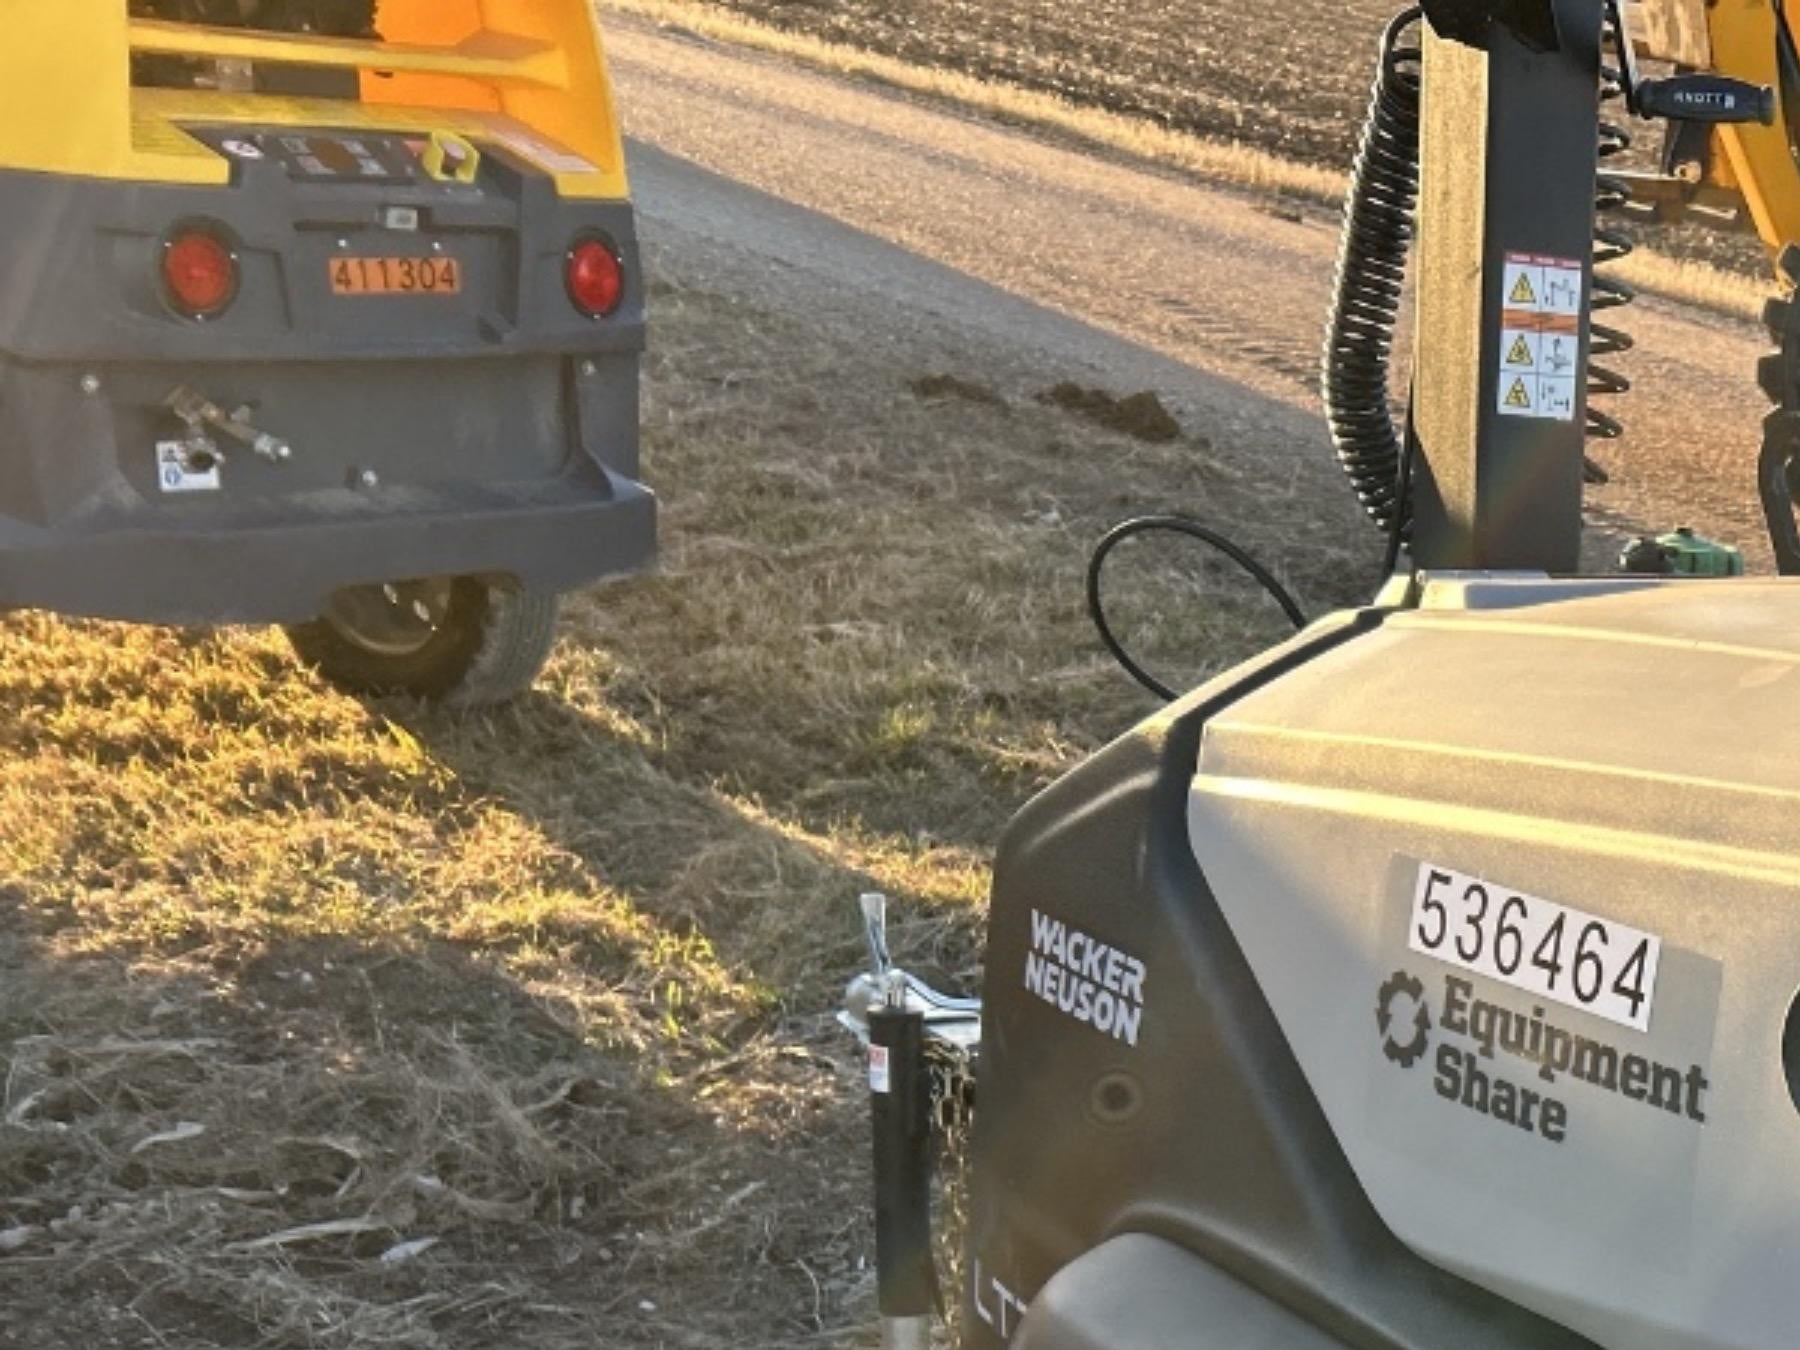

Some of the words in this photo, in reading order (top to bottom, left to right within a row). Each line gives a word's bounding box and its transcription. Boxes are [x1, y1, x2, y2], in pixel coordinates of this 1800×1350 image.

[335, 258, 455, 290] 411304
[1030, 907, 1148, 1005] WACKER
[1417, 869, 1650, 1019] 536464
[1024, 950, 1143, 1048] NEUSON
[1439, 973, 1709, 1123] Equipment
[1433, 1042, 1567, 1144] Share
[973, 1257, 1028, 1339] LT
